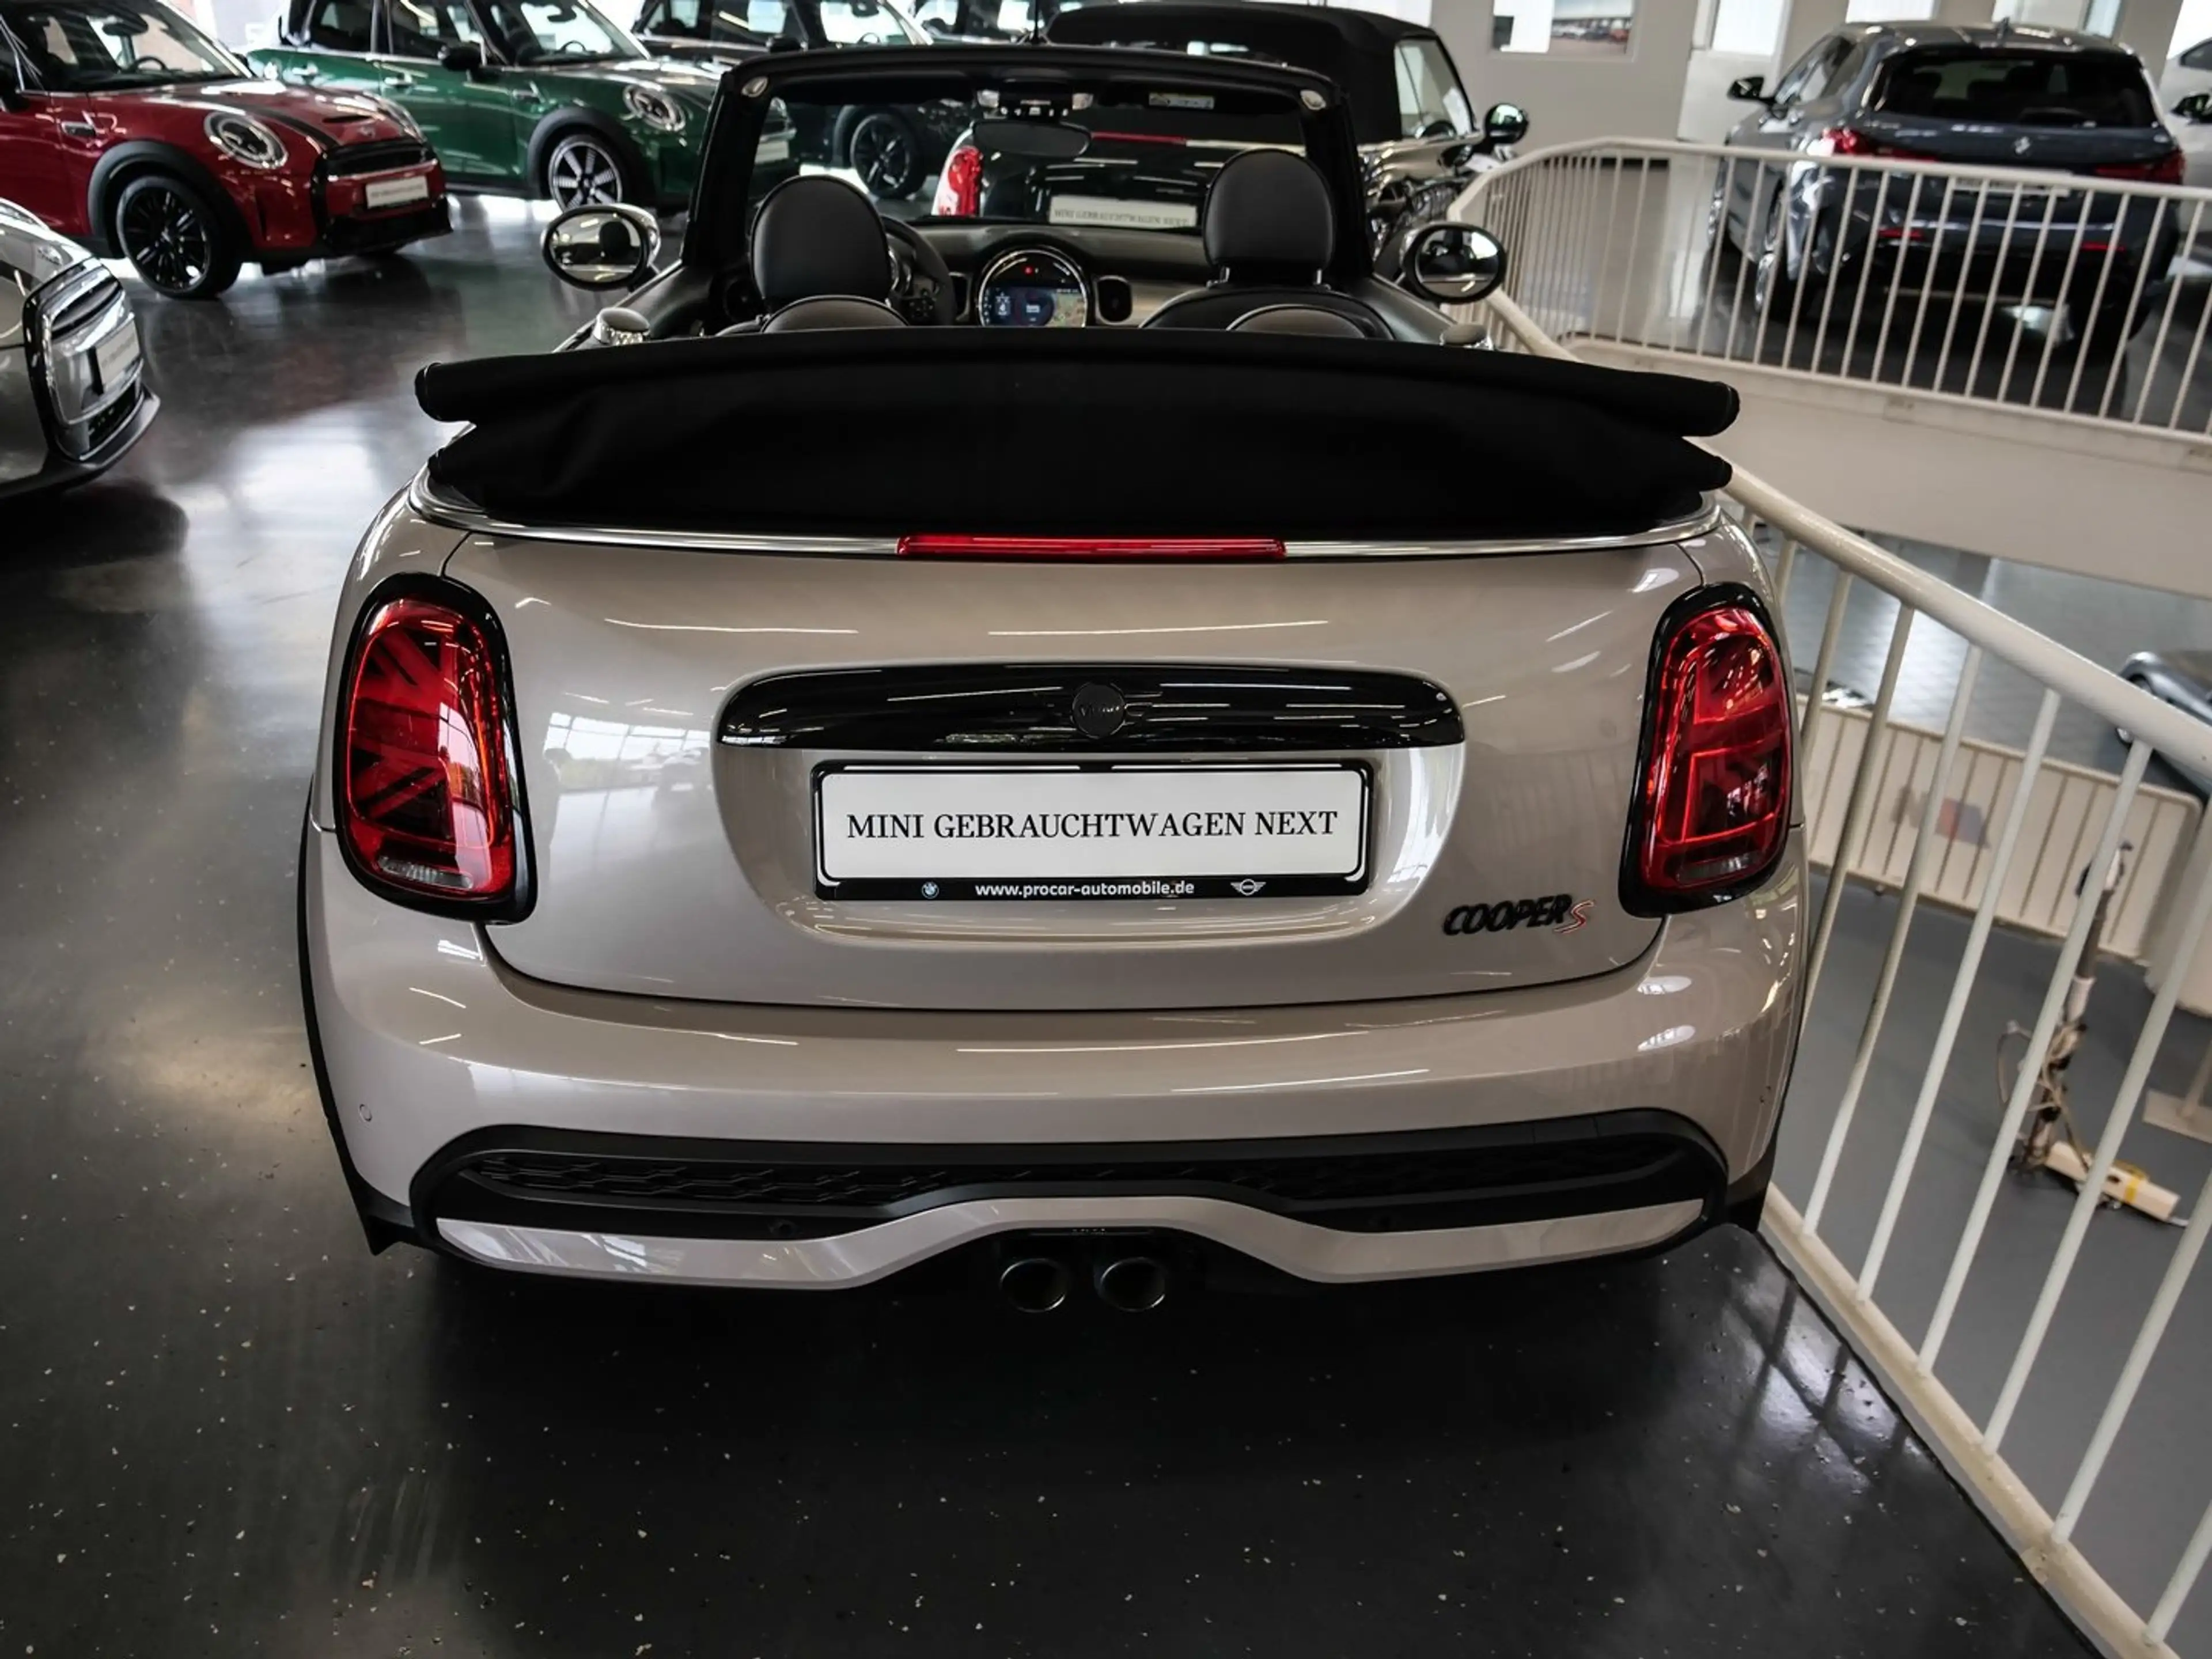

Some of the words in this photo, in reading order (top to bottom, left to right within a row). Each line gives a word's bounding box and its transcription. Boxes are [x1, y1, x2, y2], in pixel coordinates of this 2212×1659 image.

[847, 814, 925, 838] MINI
[934, 812, 1246, 838] GEBRAUCHTWAGEN
[1255, 810, 1338, 835] NEXT
[975, 881, 1195, 898] www.procar-automobile.de
[1442, 893, 1573, 936] COOPER
[1554, 899, 1594, 933] S
